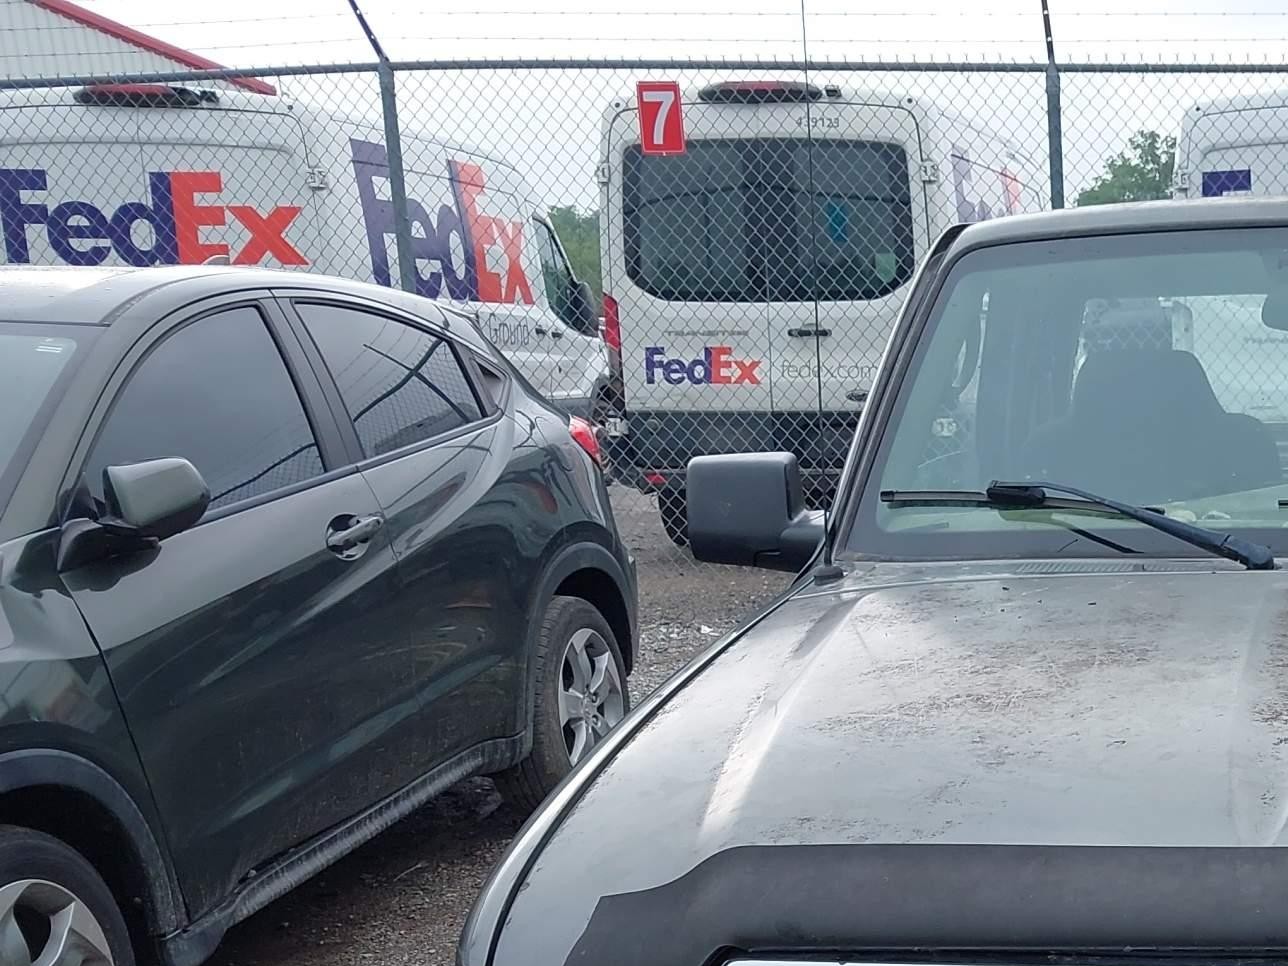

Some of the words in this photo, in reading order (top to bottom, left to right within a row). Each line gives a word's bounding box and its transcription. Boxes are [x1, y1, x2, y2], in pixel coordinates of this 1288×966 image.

[643, 91, 676, 145] 7
[0, 169, 309, 267] FedEx
[349, 138, 535, 305] FedEx
[645, 347, 762, 385] FedEx
